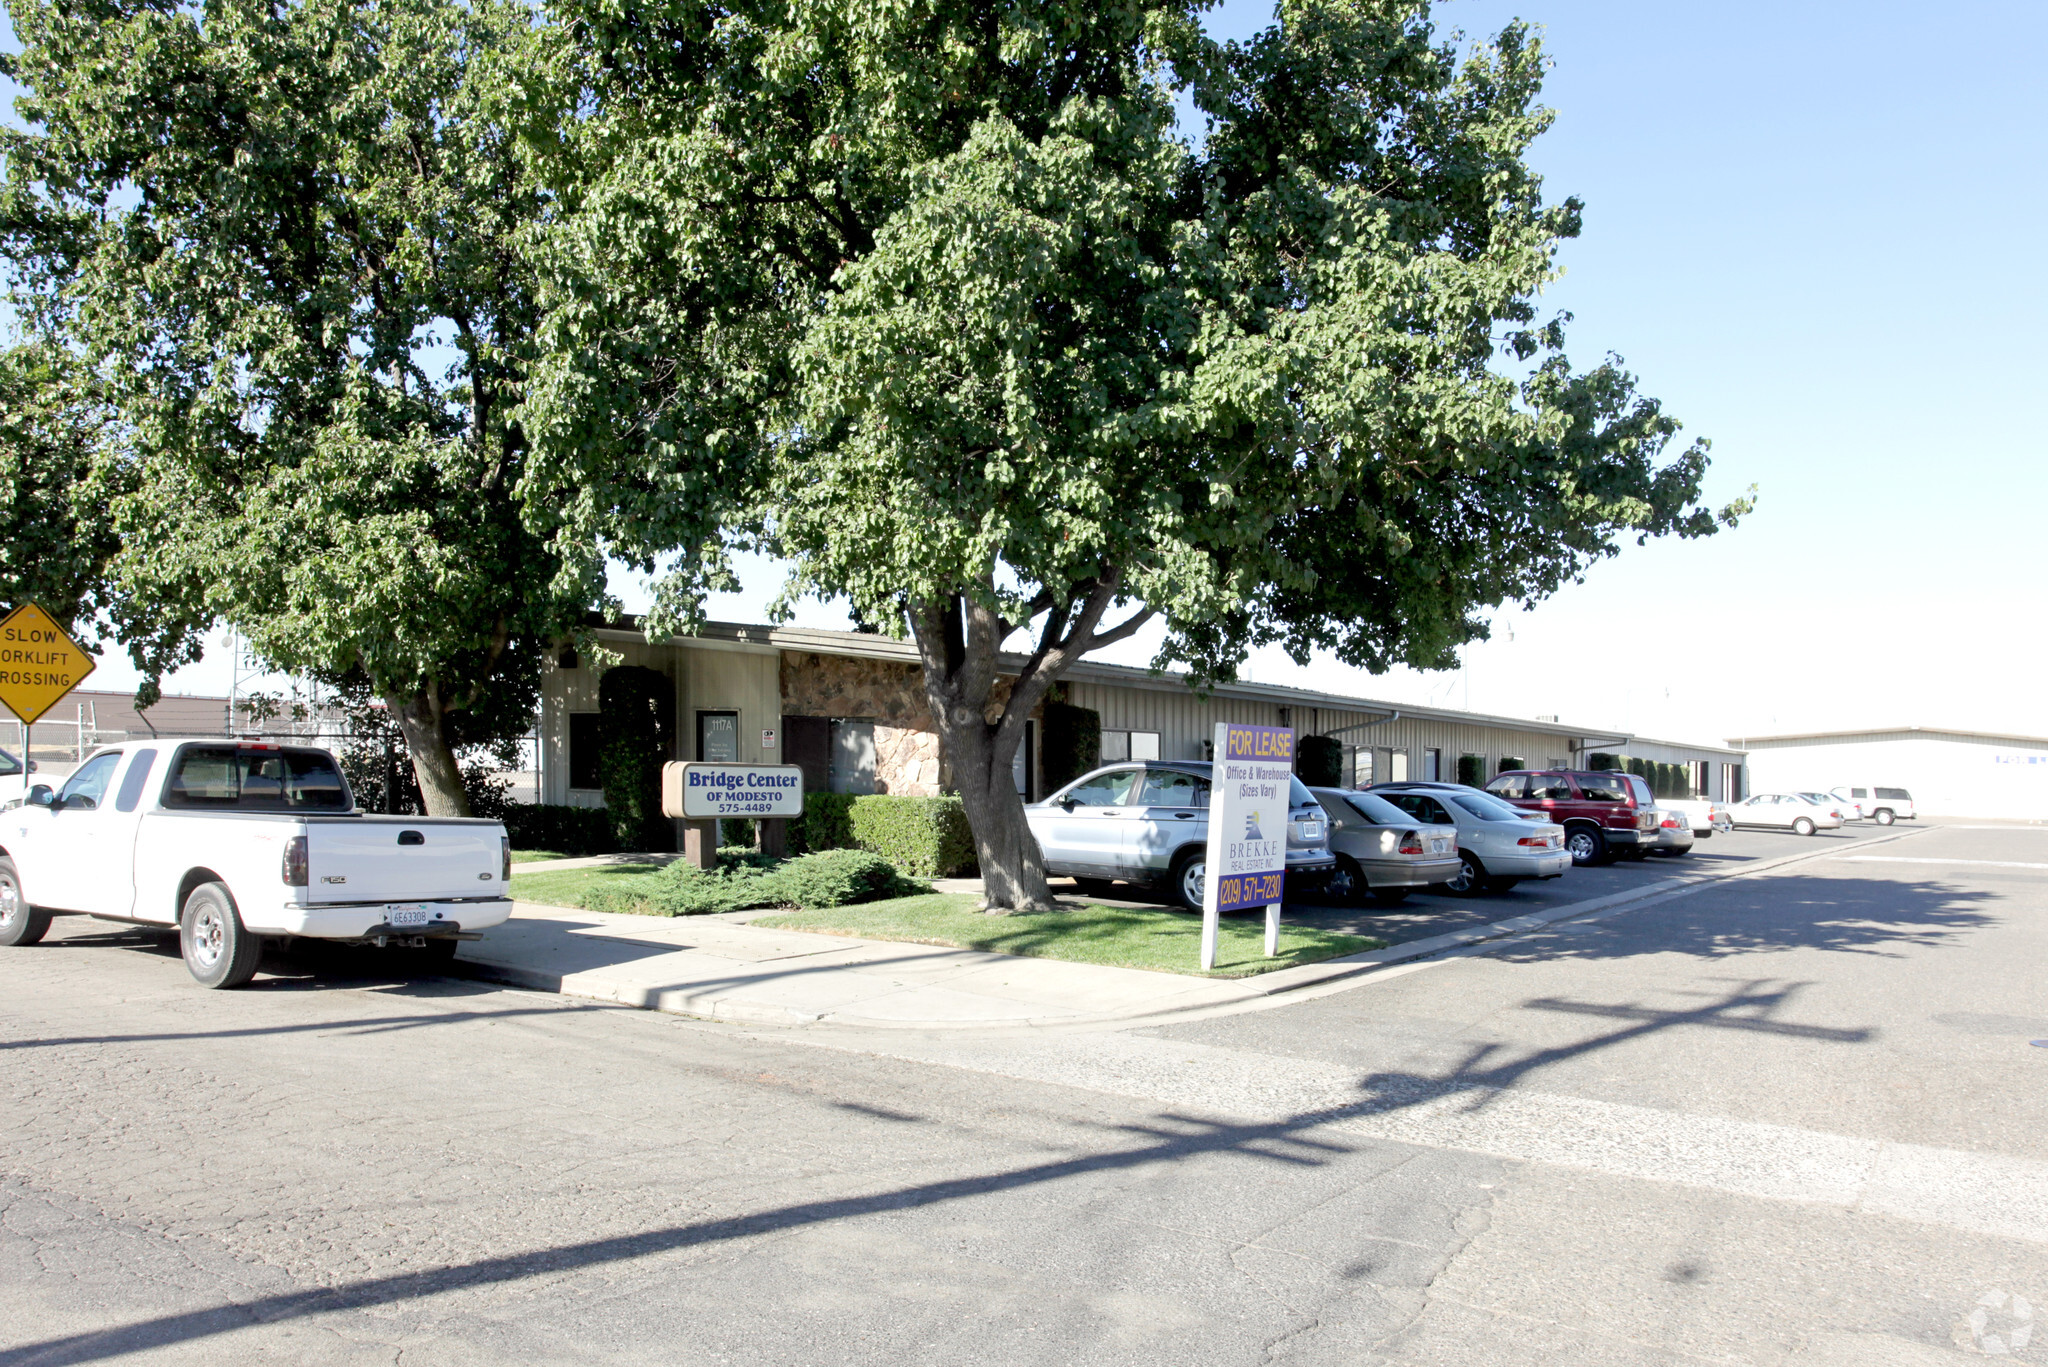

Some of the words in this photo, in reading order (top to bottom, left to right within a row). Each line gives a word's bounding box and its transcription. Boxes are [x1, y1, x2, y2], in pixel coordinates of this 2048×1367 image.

[5, 628, 57, 643] SLOW
[1, 649, 68, 665] ORKLIFT
[0, 671, 70, 687] ROSSING
[712, 719, 733, 731] 1117A
[1228, 729, 1252, 756] FOR
[1255, 731, 1291, 758] LEASE
[688, 771, 744, 790] Bridge
[747, 772, 798, 788] Center
[1226, 765, 1247, 780] Office
[1249, 766, 1254, 780] &
[1256, 766, 1290, 780] Warehouse
[707, 791, 723, 802] OF
[725, 791, 783, 802] MODESTO
[1239, 783, 1259, 800] (Sizes
[1260, 784, 1277, 800] Vary)
[718, 803, 772, 813] 575-4489
[1229, 840, 1278, 859] BREKKE
[1231, 860, 1245, 872] REAL
[1246, 858, 1264, 871] ESTATE
[1220, 878, 1242, 907] (209)
[1243, 874, 1281, 902] 571-7230
